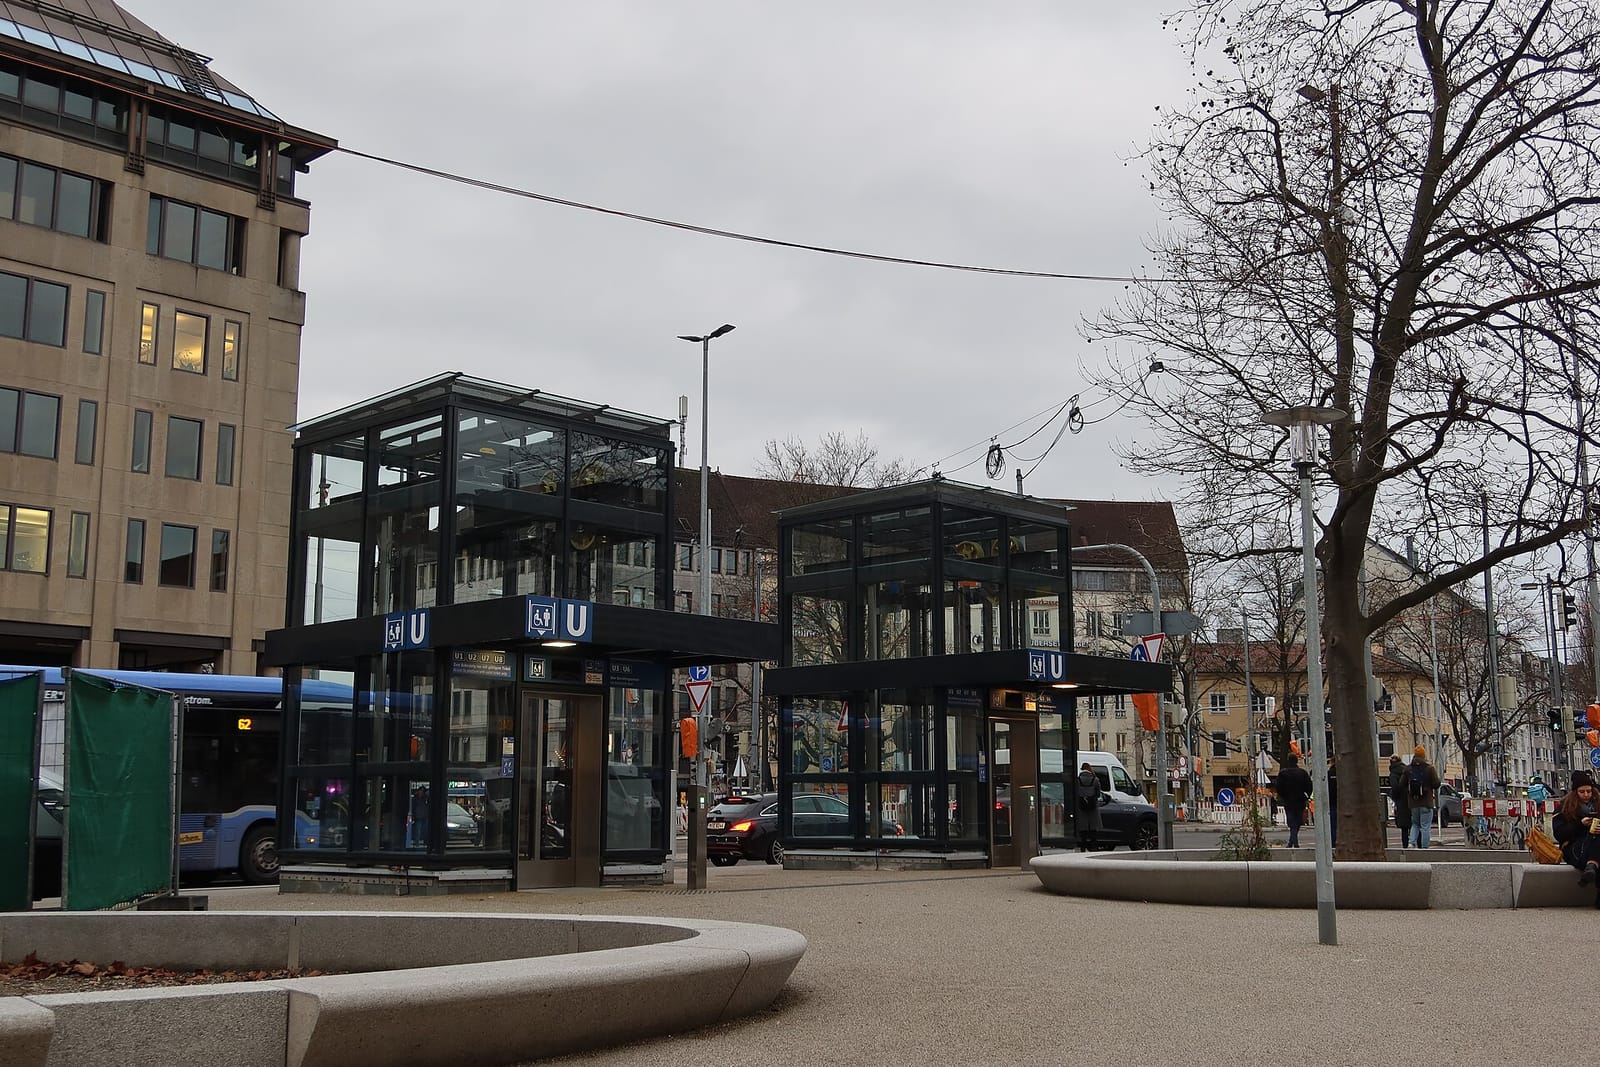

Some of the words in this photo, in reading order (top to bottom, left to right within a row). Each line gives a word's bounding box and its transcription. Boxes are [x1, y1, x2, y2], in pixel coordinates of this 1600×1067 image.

[411, 613, 425, 643] U
[567, 604, 586, 636] U
[454, 652, 463, 660] U1
[468, 653, 477, 661] U2
[1051, 655, 1062, 678] U
[238, 718, 252, 731] 62
